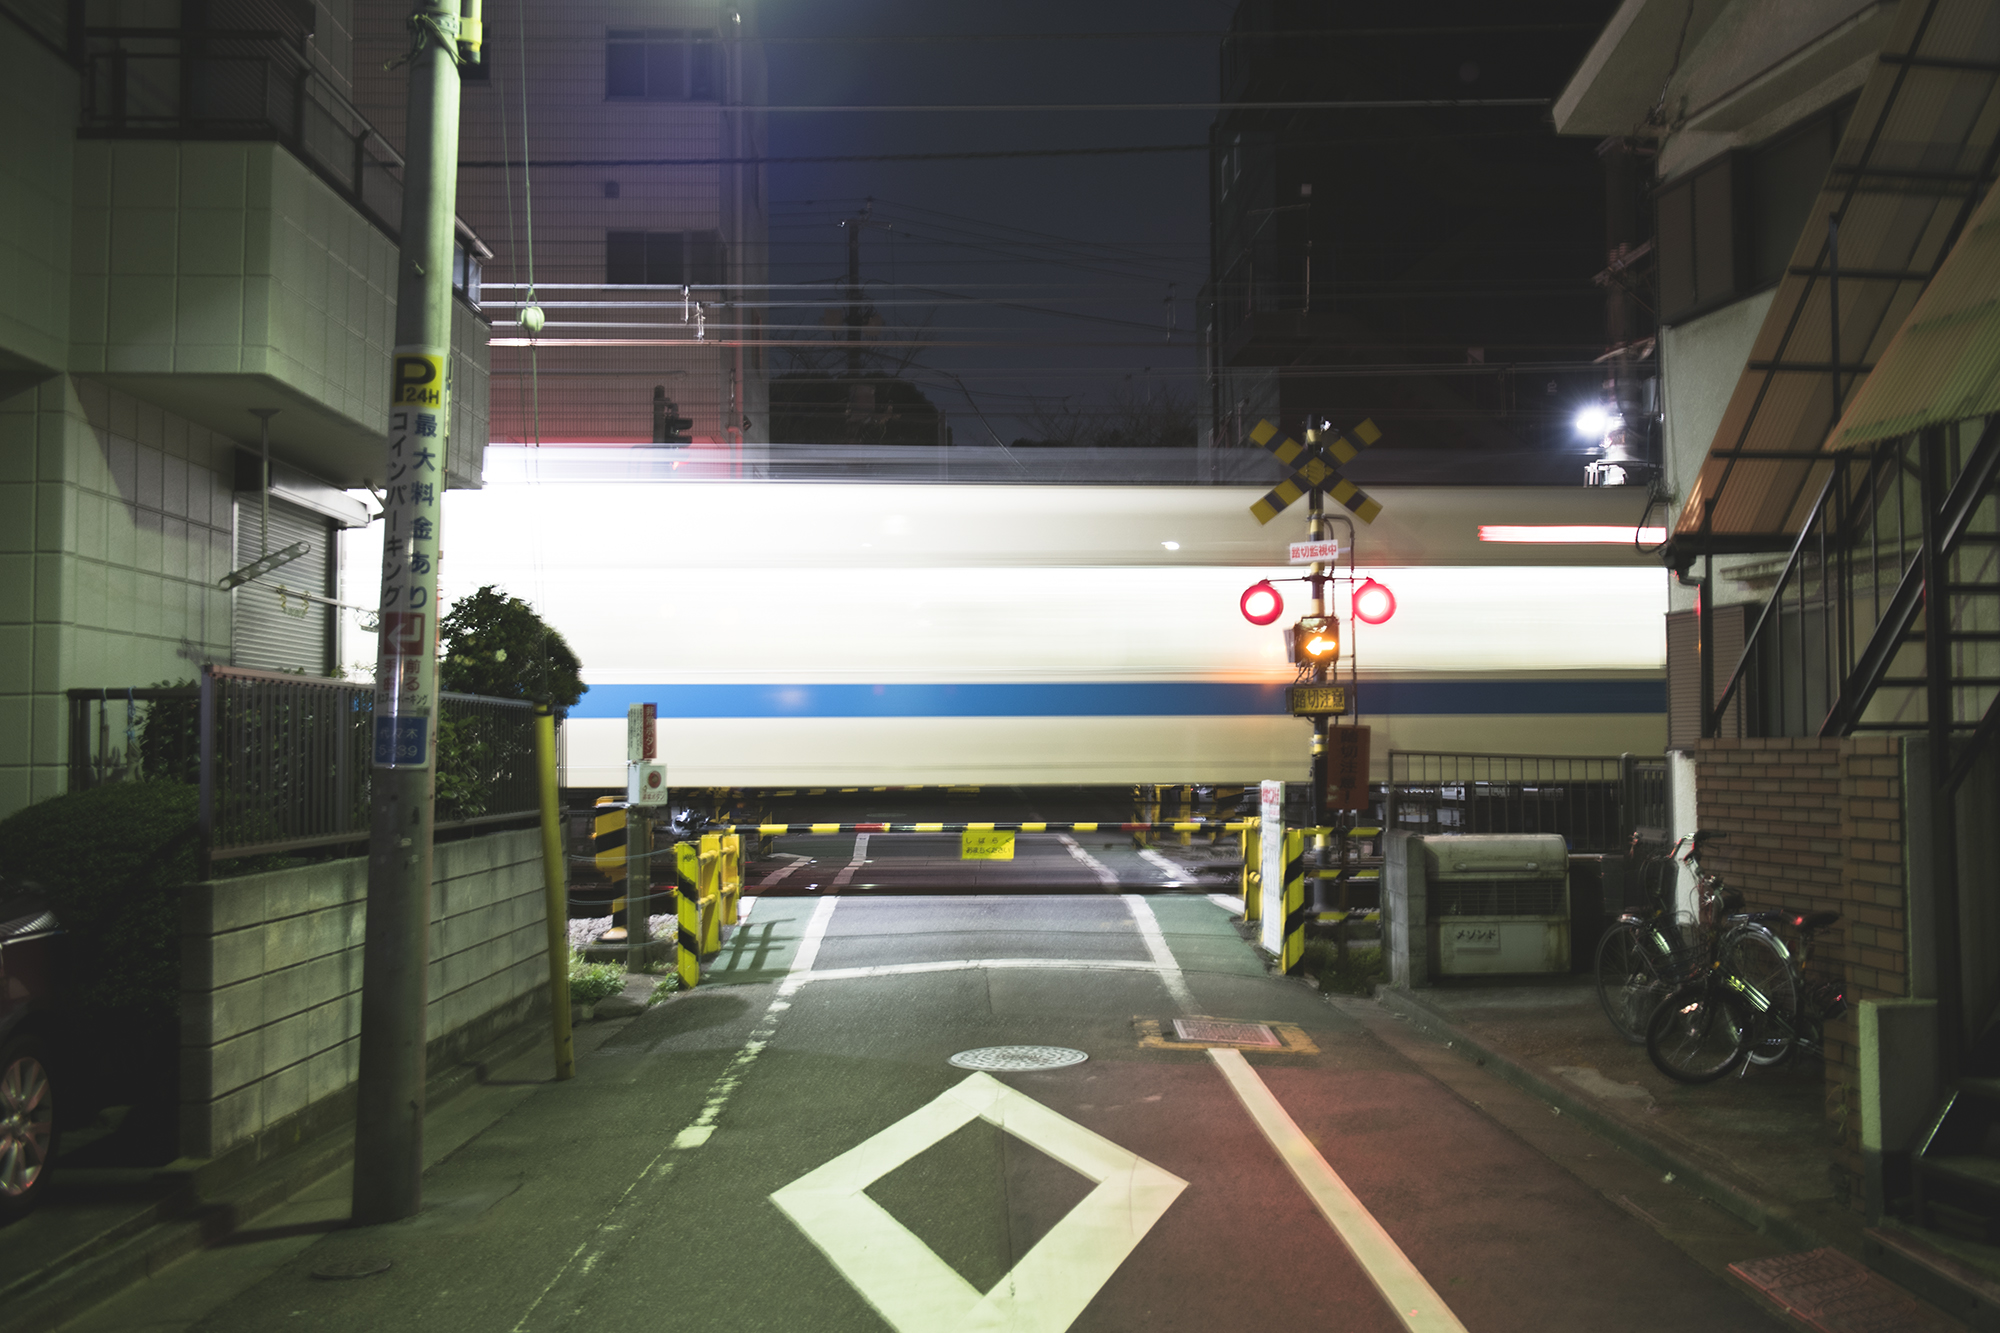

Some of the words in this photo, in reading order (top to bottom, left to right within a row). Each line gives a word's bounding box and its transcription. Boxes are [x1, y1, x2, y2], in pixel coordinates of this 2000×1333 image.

[395, 357, 437, 404] P
[406, 387, 439, 404] 24H
[385, 412, 408, 607] コインパーキング
[409, 412, 437, 609] 最大料金あり
[1291, 543, 1337, 559] 踏切監視中
[1294, 688, 1345, 709] 踏切注意
[645, 705, 656, 756] 非常ボタン
